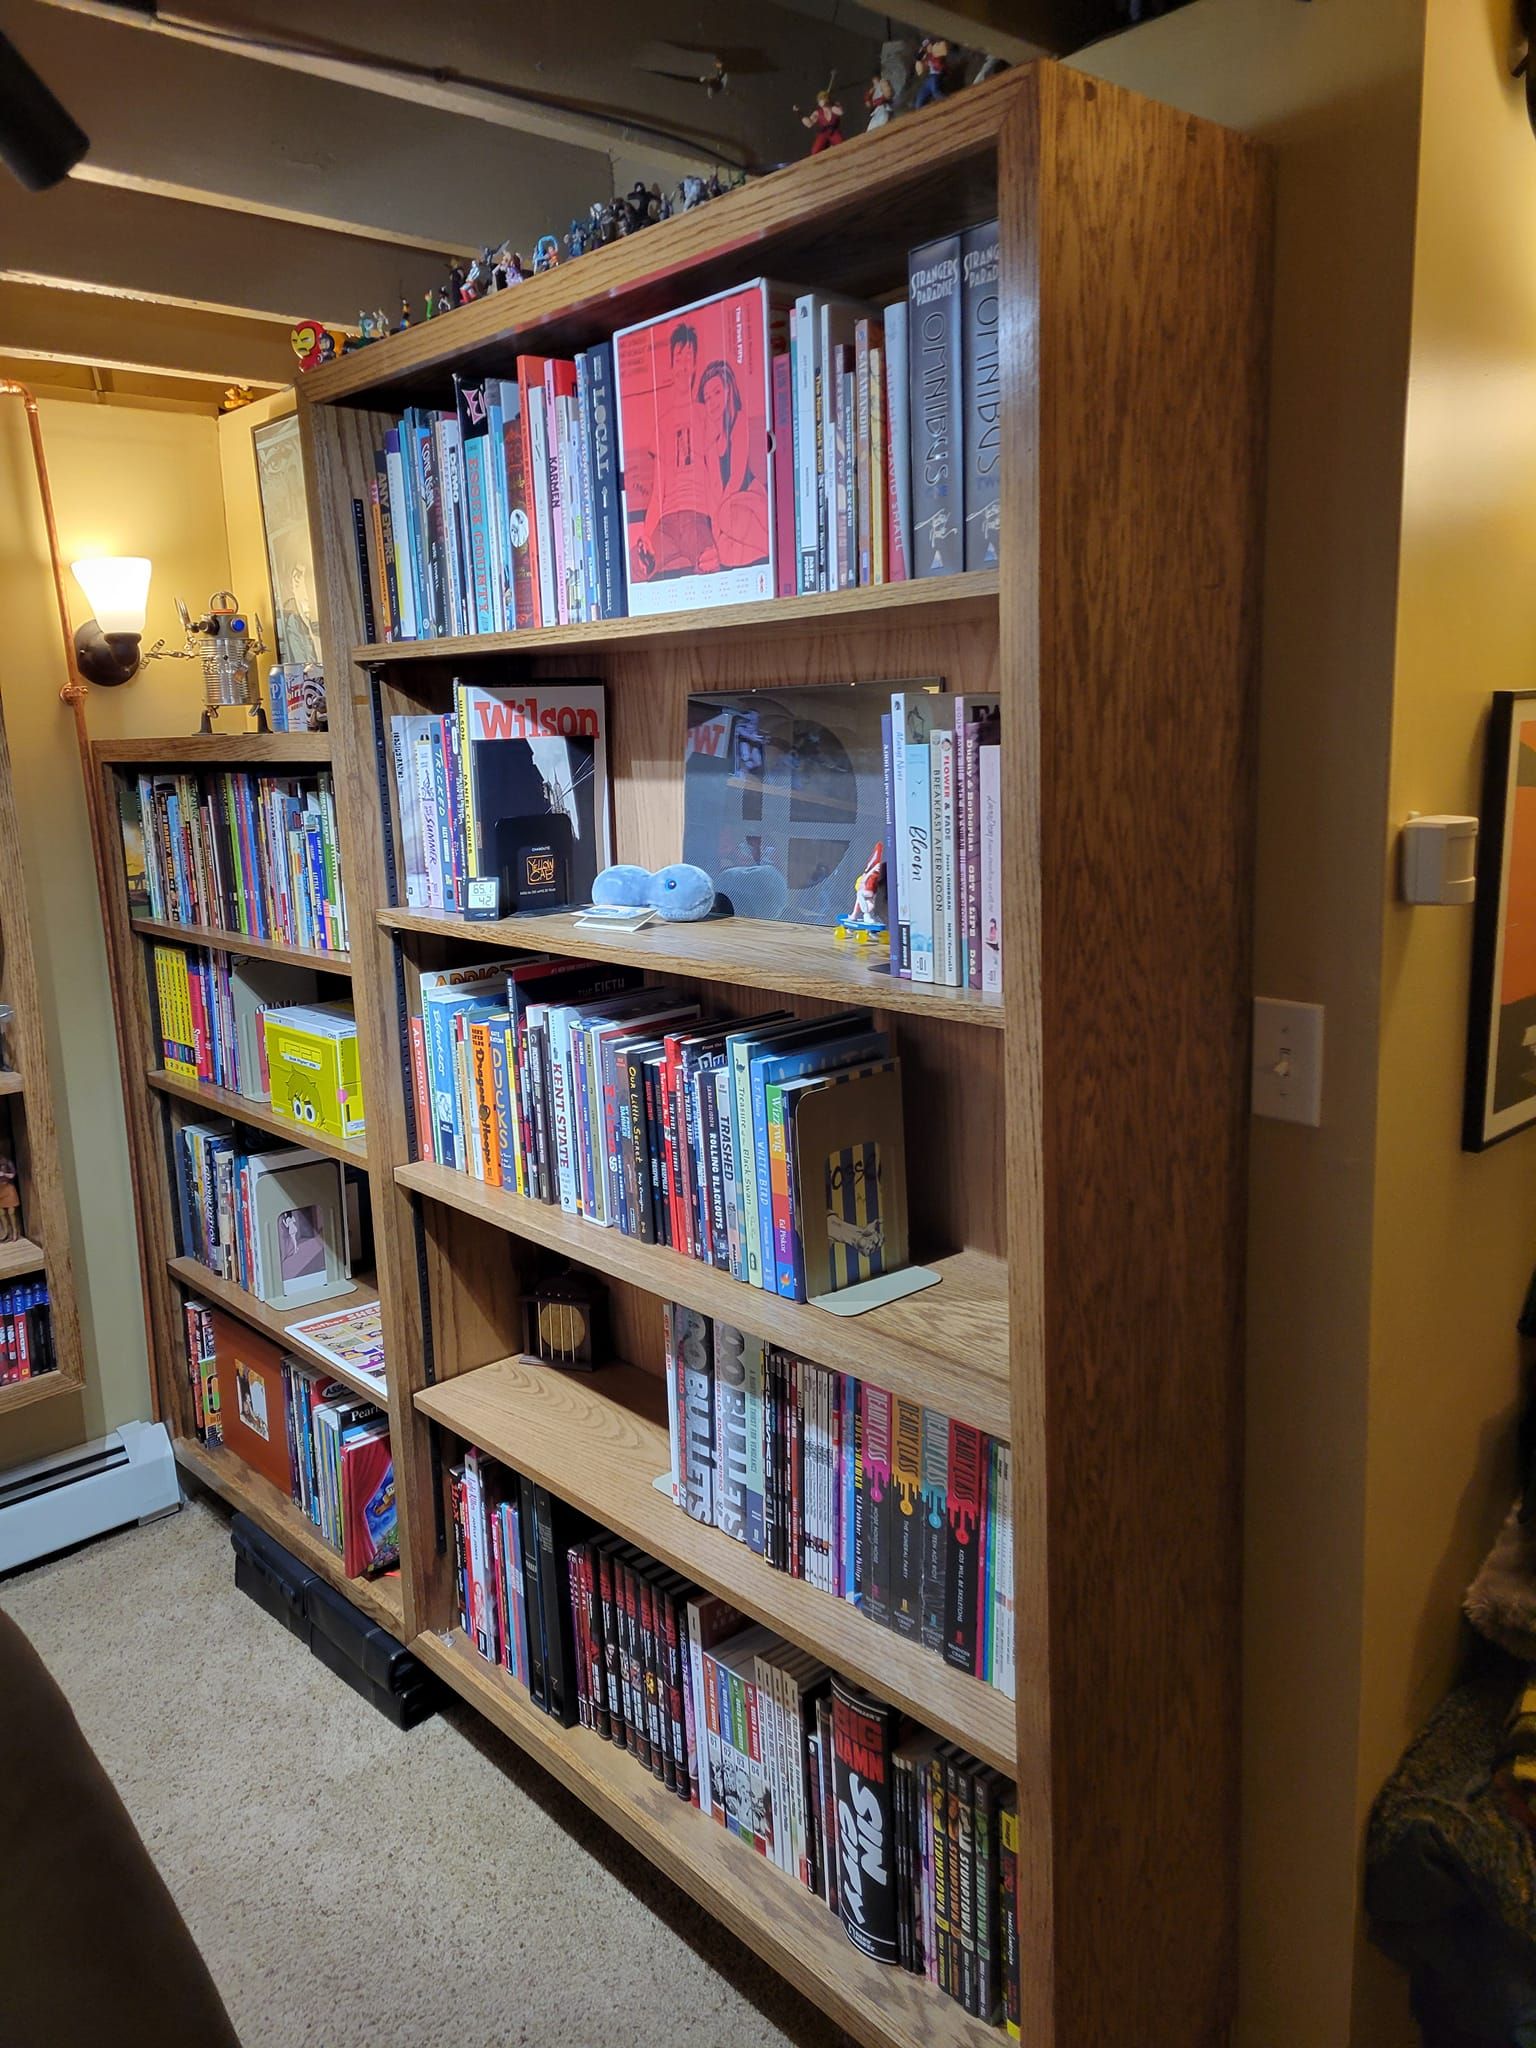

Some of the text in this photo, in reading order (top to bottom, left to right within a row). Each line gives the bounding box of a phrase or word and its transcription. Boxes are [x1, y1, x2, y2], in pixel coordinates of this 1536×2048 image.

[912, 259, 957, 299] STRANGERS
[917, 279, 952, 306] PARADISE
[964, 243, 1000, 281] STRANG
[969, 265, 999, 288] PARAD
[922, 311, 948, 486] OMNIBUS
[976, 295, 999, 474] OMNIBUS
[593, 386, 610, 481] LOCAL
[449, 453, 459, 503] DEMO
[549, 456, 561, 509] KARMEN
[887, 444, 903, 552] DAVID SMALL
[377, 472, 394, 565] ANY EMPIRE
[468, 457, 488, 613] ESSEX COUNTY
[474, 698, 599, 739] Wilson
[943, 755, 951, 798] FLOWER
[966, 740, 974, 777] Dupuy
[163, 824, 174, 879] BARRY WEEN
[424, 816, 437, 865] SUMMER
[909, 826, 928, 881] Bloom
[933, 770, 943, 912] BREAKFAST AFTER NOON
[312, 872, 322, 915] LITTLE THINGS
[594, 978, 625, 994] FIFTH
[433, 1008, 446, 1077] Blankets
[476, 1048, 492, 1166] Dragon Hoops
[493, 1047, 509, 1149] DUCKS
[553, 1063, 569, 1168] KENT STATE
[619, 1106, 627, 1138] DAHMER
[629, 1066, 640, 1122] OUR Little
[770, 1096, 784, 1152] Wizzywig
[651, 1158, 659, 1187] PERSEPOLIS
[720, 1116, 733, 1181] TRASHED
[738, 1087, 753, 1205] Treasure Black Swan
[757, 1140, 769, 1206] WHITE BIRD
[709, 1133, 723, 1229] ROLLING BLACKOUTS
[778, 1219, 788, 1253] Ed Piskor
[302, 1318, 344, 1332] whither
[720, 1325, 748, 1542] 00 BULLETS
[764, 1341, 772, 1477] BLACKSAD
[866, 1389, 888, 1466] DEADLY CLASS
[897, 1400, 920, 1477] DEADLY CLASS
[686, 1368, 713, 1526] BULLETS
[855, 1447, 863, 1489] SUMMER
[925, 1452, 948, 1489] CLASS
[954, 1425, 977, 1504] DEADLY CLASS
[855, 1556, 863, 1582] Phillips
[832, 1698, 883, 1749] BIG
[835, 1732, 884, 1784] DAMN
[838, 1800, 866, 1924] CITY
[849, 1772, 888, 1887] SIN
[934, 1833, 945, 1914] STUMPTOWN
[948, 1842, 960, 1923] STUMPTOWN
[960, 1853, 971, 1934] STUMPTOWN
[976, 1862, 987, 1942] STUMPTOWN
